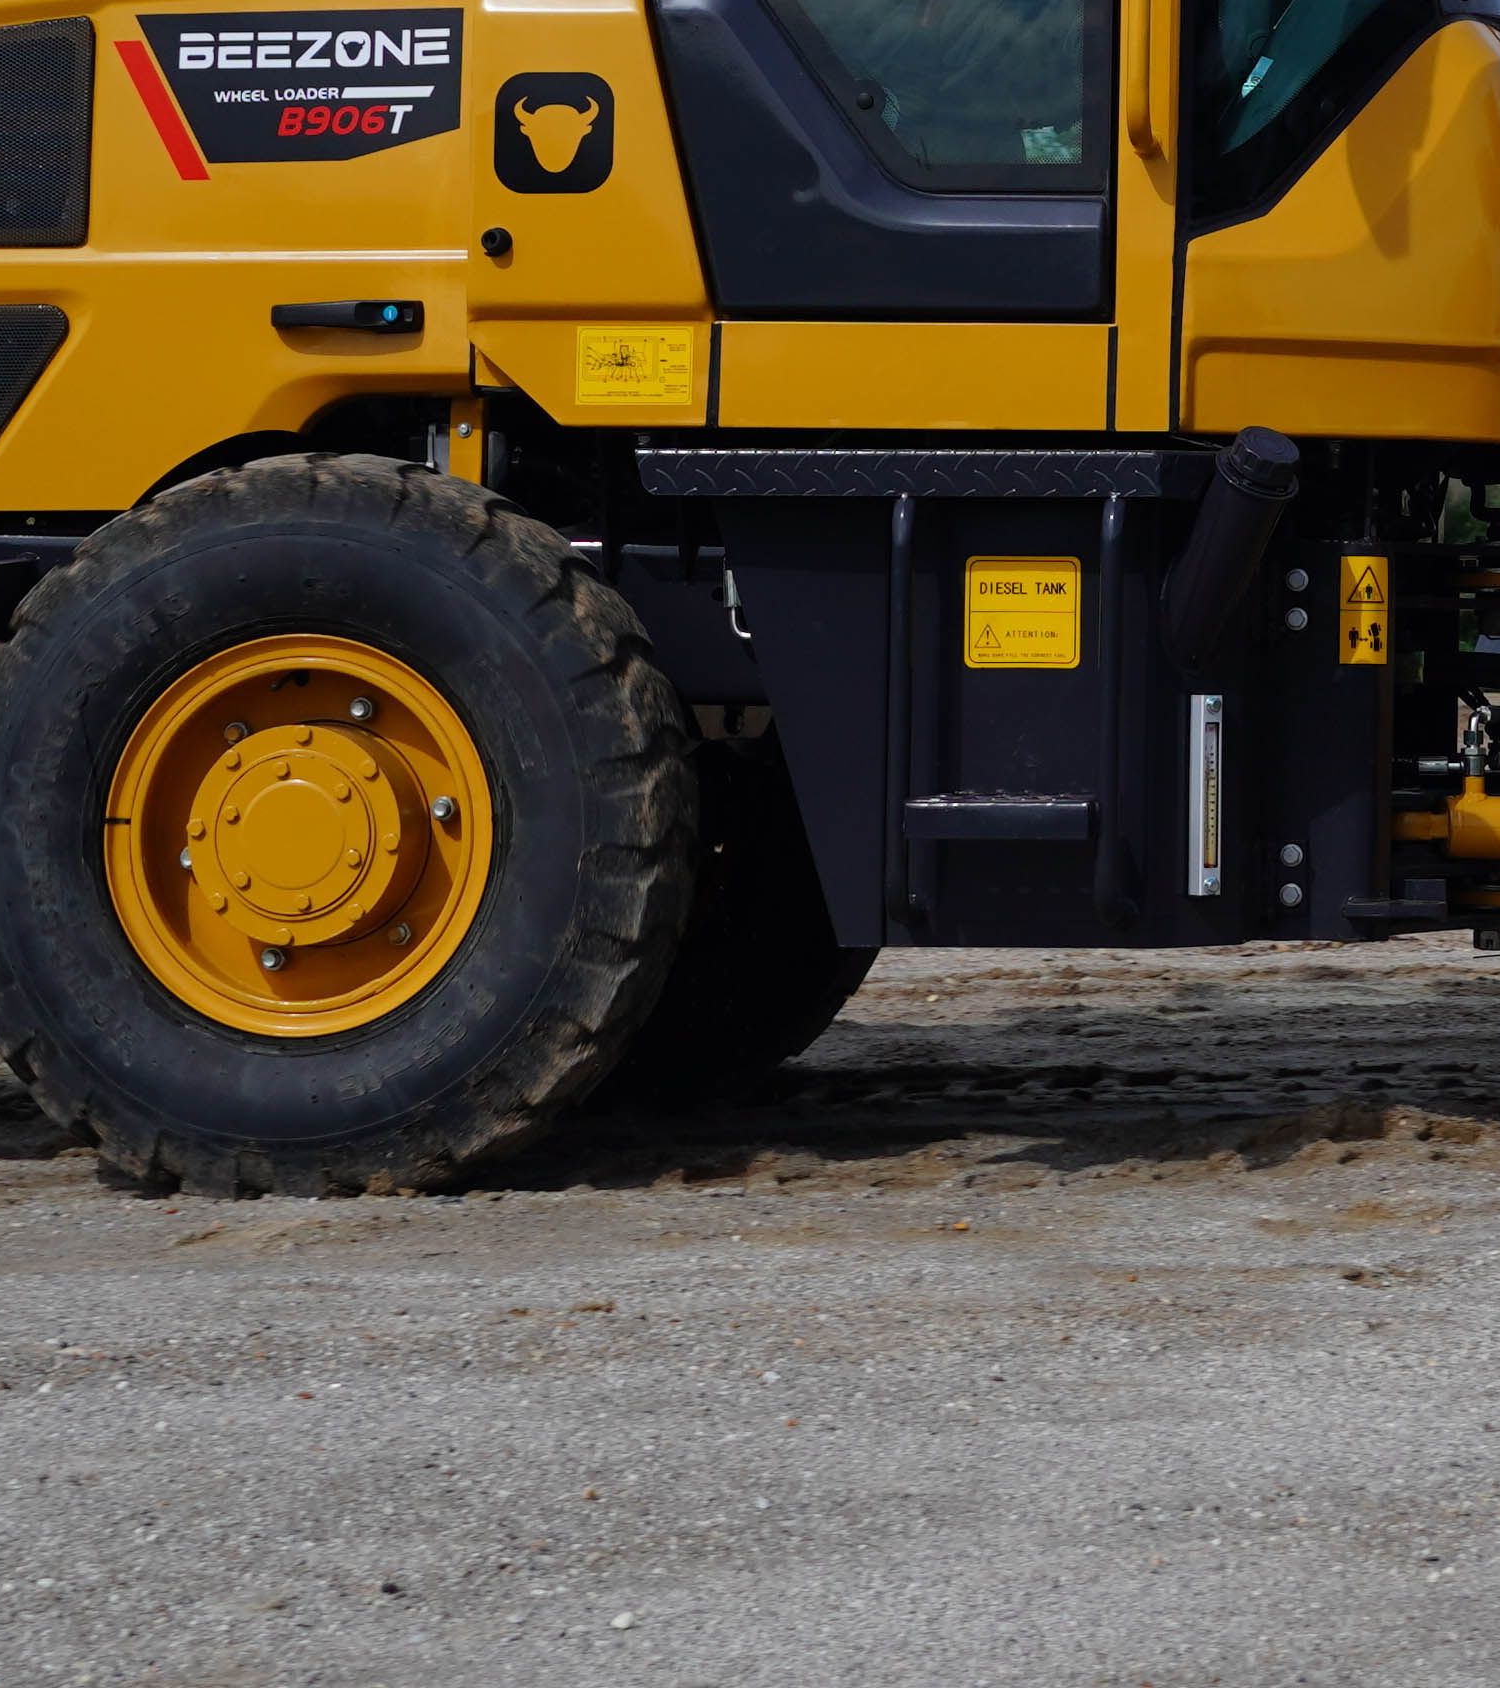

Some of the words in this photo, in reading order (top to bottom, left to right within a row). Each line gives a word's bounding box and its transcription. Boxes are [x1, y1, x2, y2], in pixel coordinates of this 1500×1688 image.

[178, 27, 451, 69] BEEZONE
[213, 88, 270, 103] WHEEL
[274, 86, 340, 101] LOADER
[277, 104, 414, 137] B906T
[979, 581, 1028, 595] DIESEL
[1035, 581, 1067, 595] TANK
